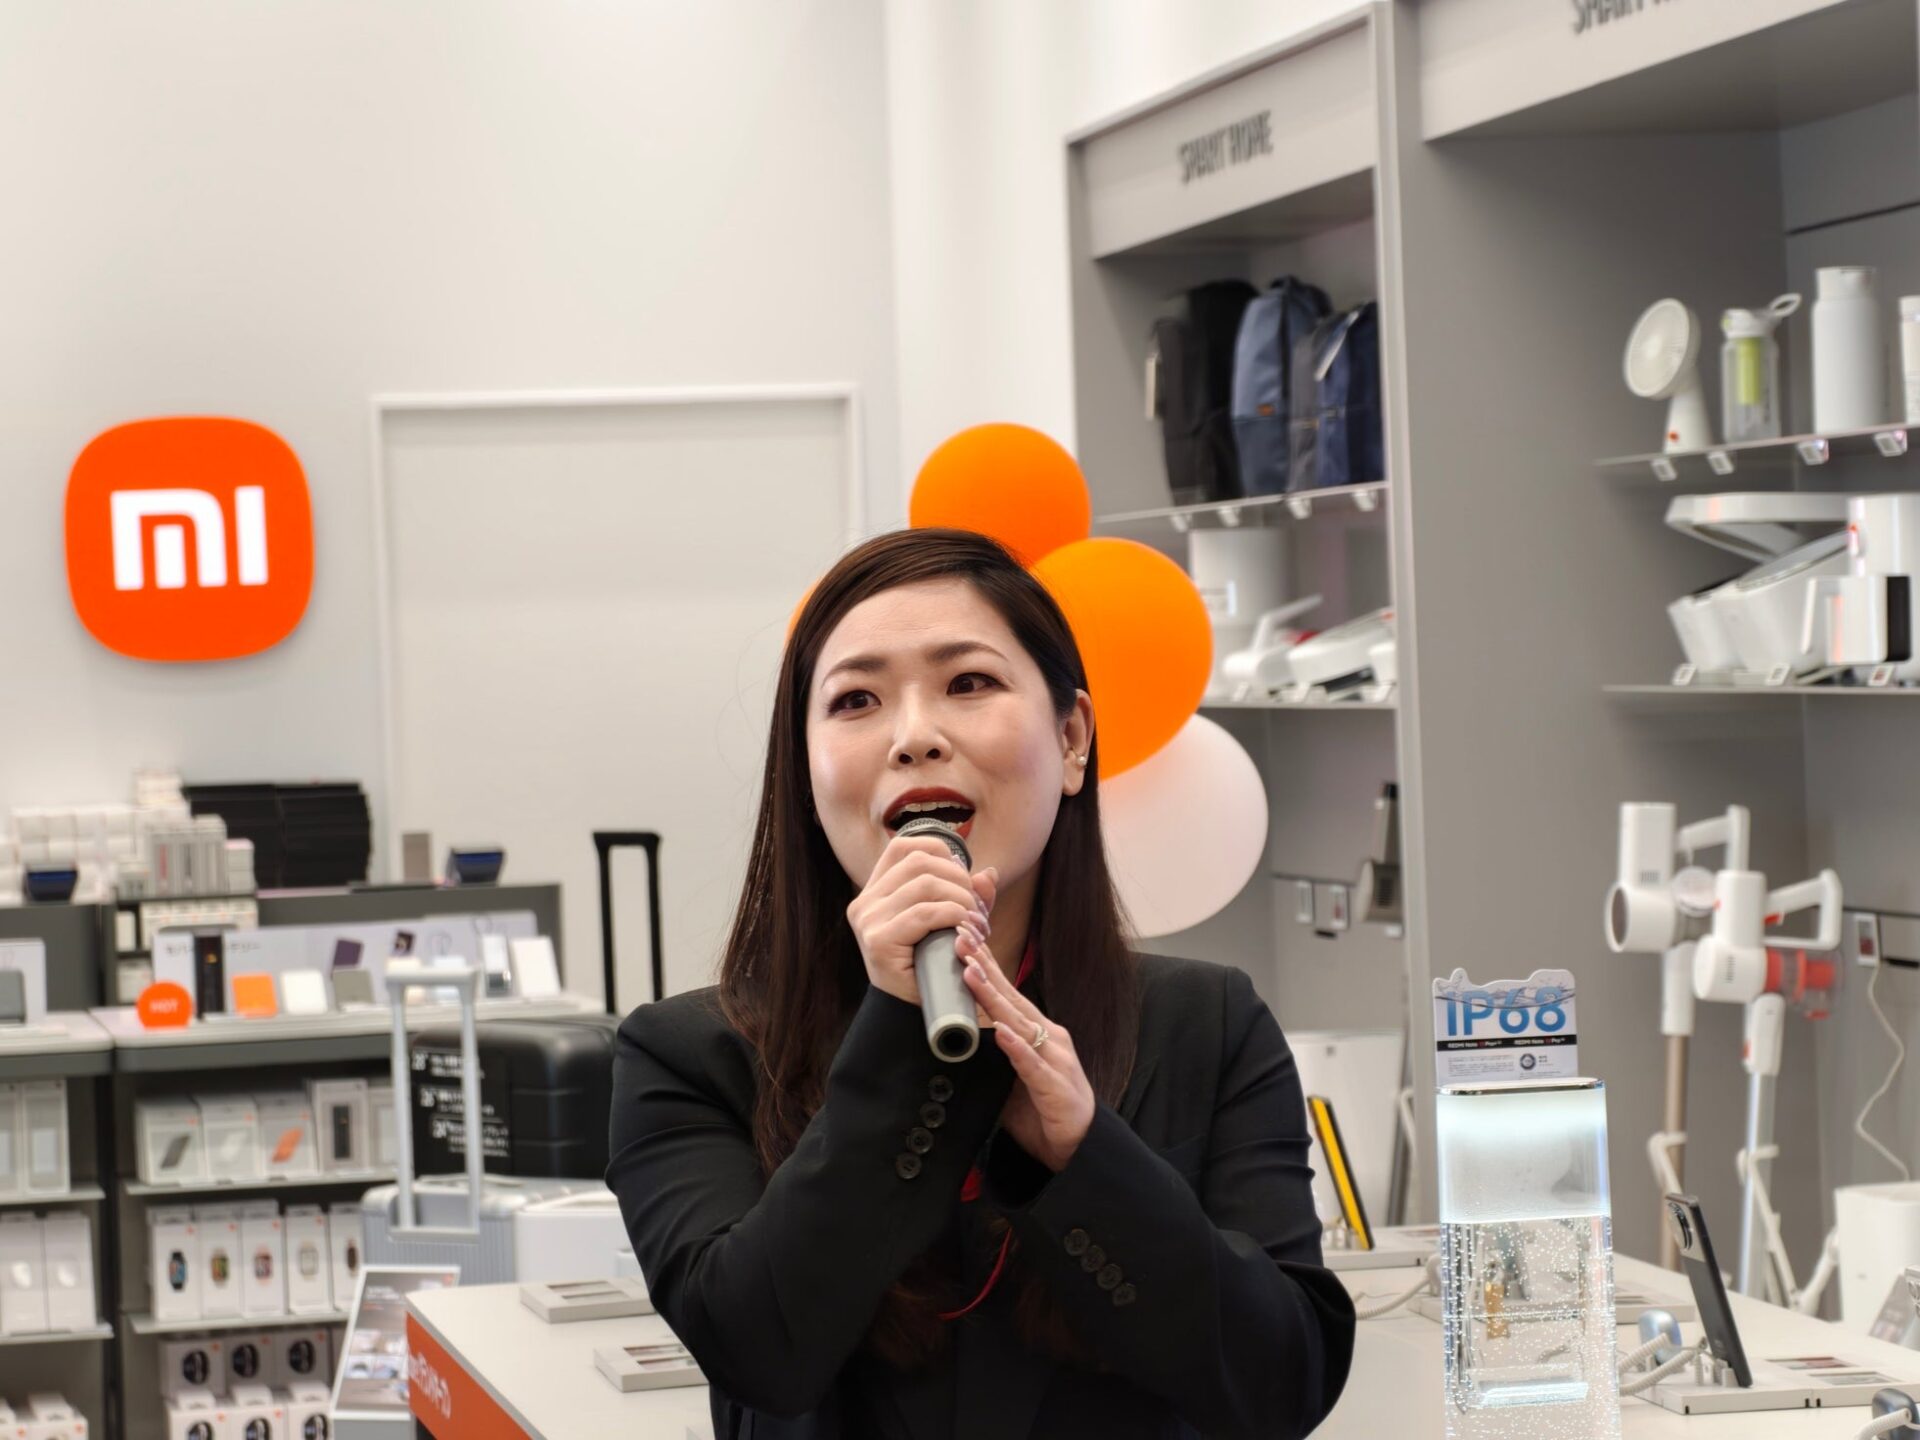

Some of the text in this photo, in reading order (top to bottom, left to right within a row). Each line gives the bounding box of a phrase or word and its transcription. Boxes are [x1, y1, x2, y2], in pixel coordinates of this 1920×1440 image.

[1178, 109, 1274, 186] SMART HOME
[1446, 986, 1566, 1036] IP68
